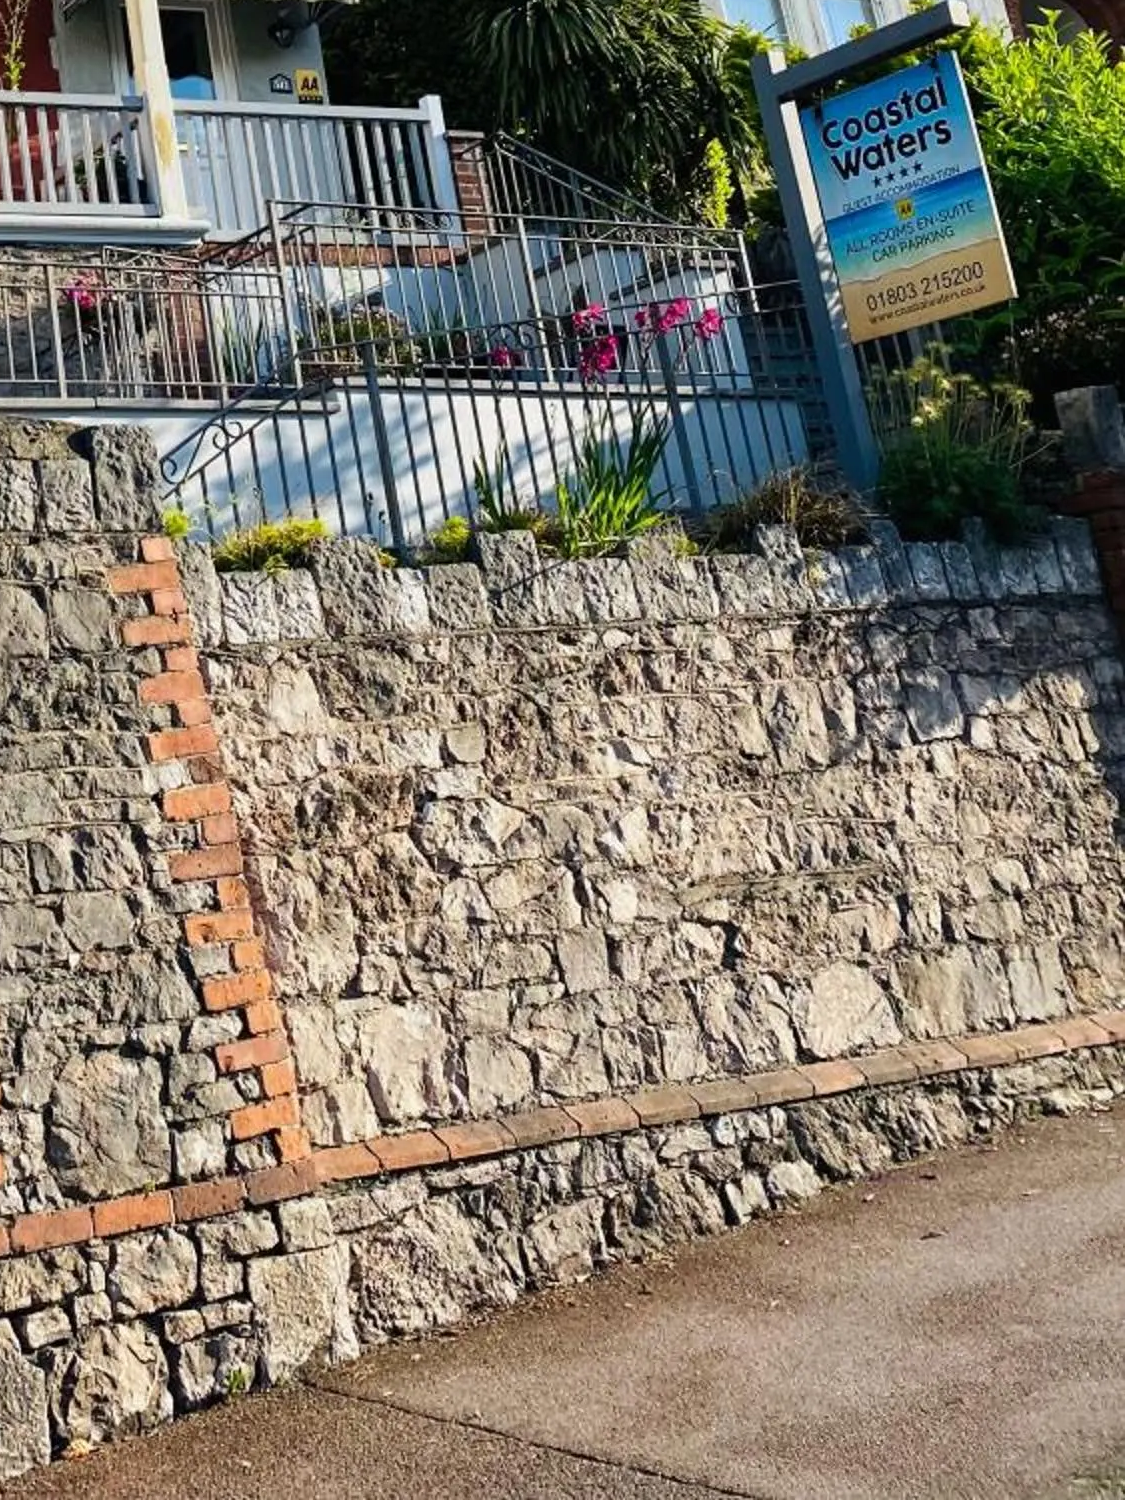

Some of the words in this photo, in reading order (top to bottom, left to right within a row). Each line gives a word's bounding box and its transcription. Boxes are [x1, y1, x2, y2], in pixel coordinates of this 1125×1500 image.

[300, 76, 320, 91] AA
[822, 76, 948, 149] Coastal
[830, 119, 952, 181] Waters
[846, 239, 868, 256] ALL
[869, 221, 916, 248] ROOMS
[872, 243, 897, 263] CAR
[898, 224, 956, 253] PARKING
[867, 282, 918, 312] 01803
[920, 261, 984, 296] 215200
